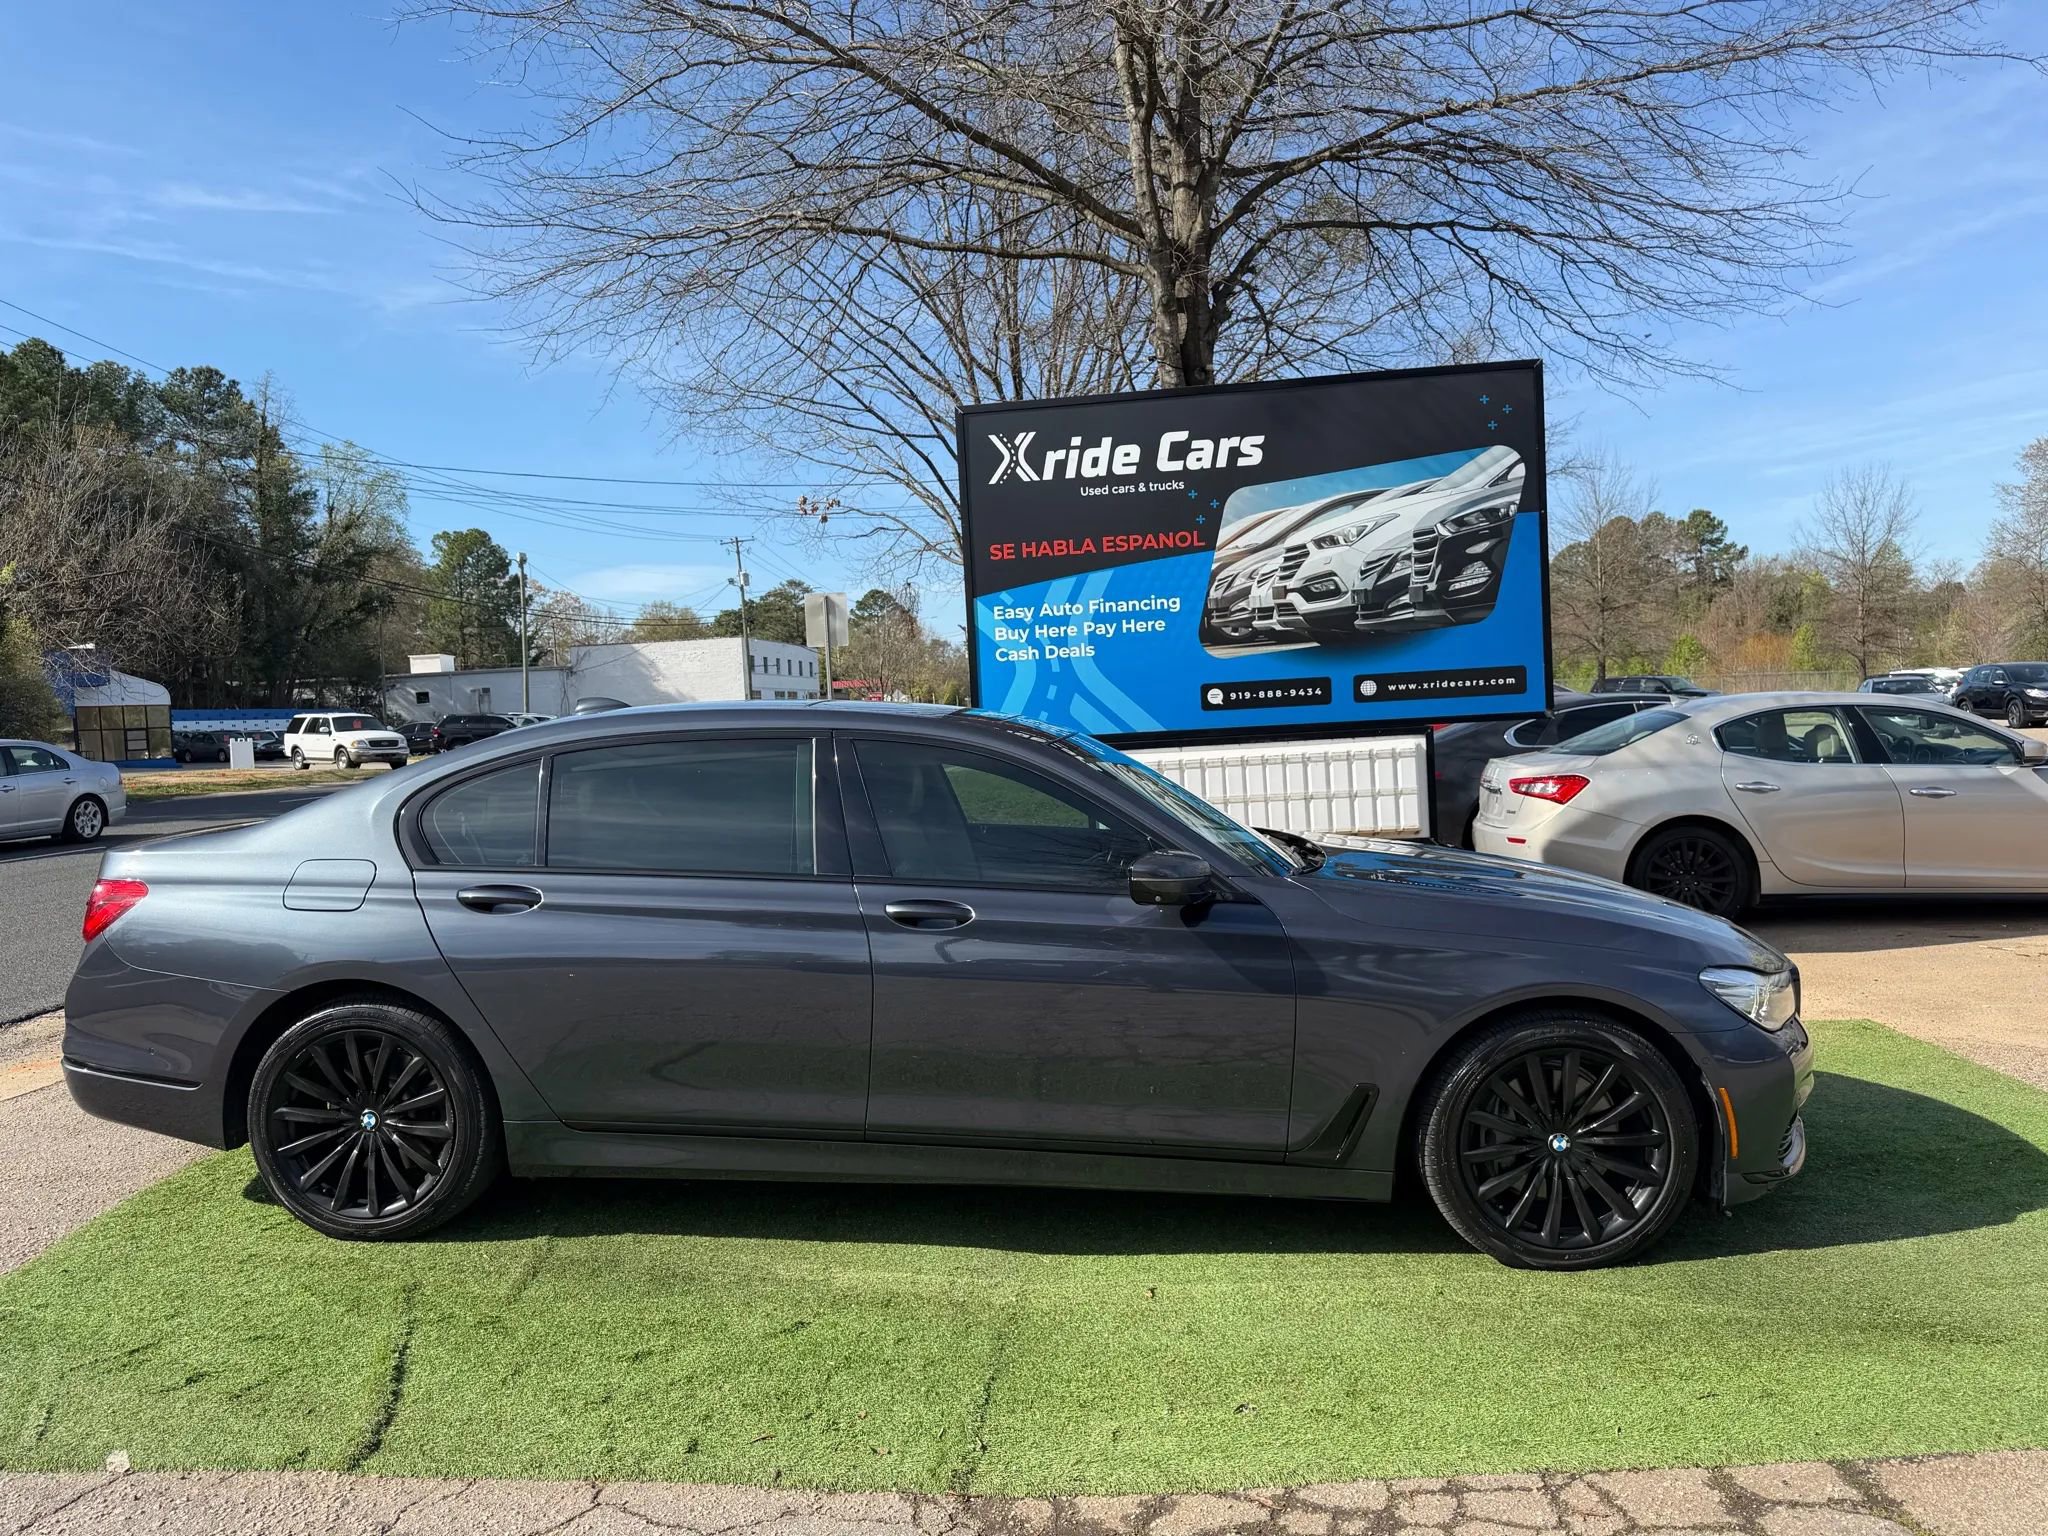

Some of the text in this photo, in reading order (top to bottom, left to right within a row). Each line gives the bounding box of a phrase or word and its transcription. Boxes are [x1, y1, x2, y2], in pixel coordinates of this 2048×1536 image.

[1156, 430, 1265, 472] Cars
[1080, 480, 1185, 496] Used cars & trucks
[989, 531, 1206, 561] SE HABLA ESPANOL
[993, 595, 1181, 622] Easy Auto Financing
[994, 619, 1166, 643] Buy Here Pay Here
[995, 643, 1095, 662] Cash Deals
[1229, 687, 1323, 700] 919-888-9434
[1387, 677, 1516, 691] www.xridecars.com
